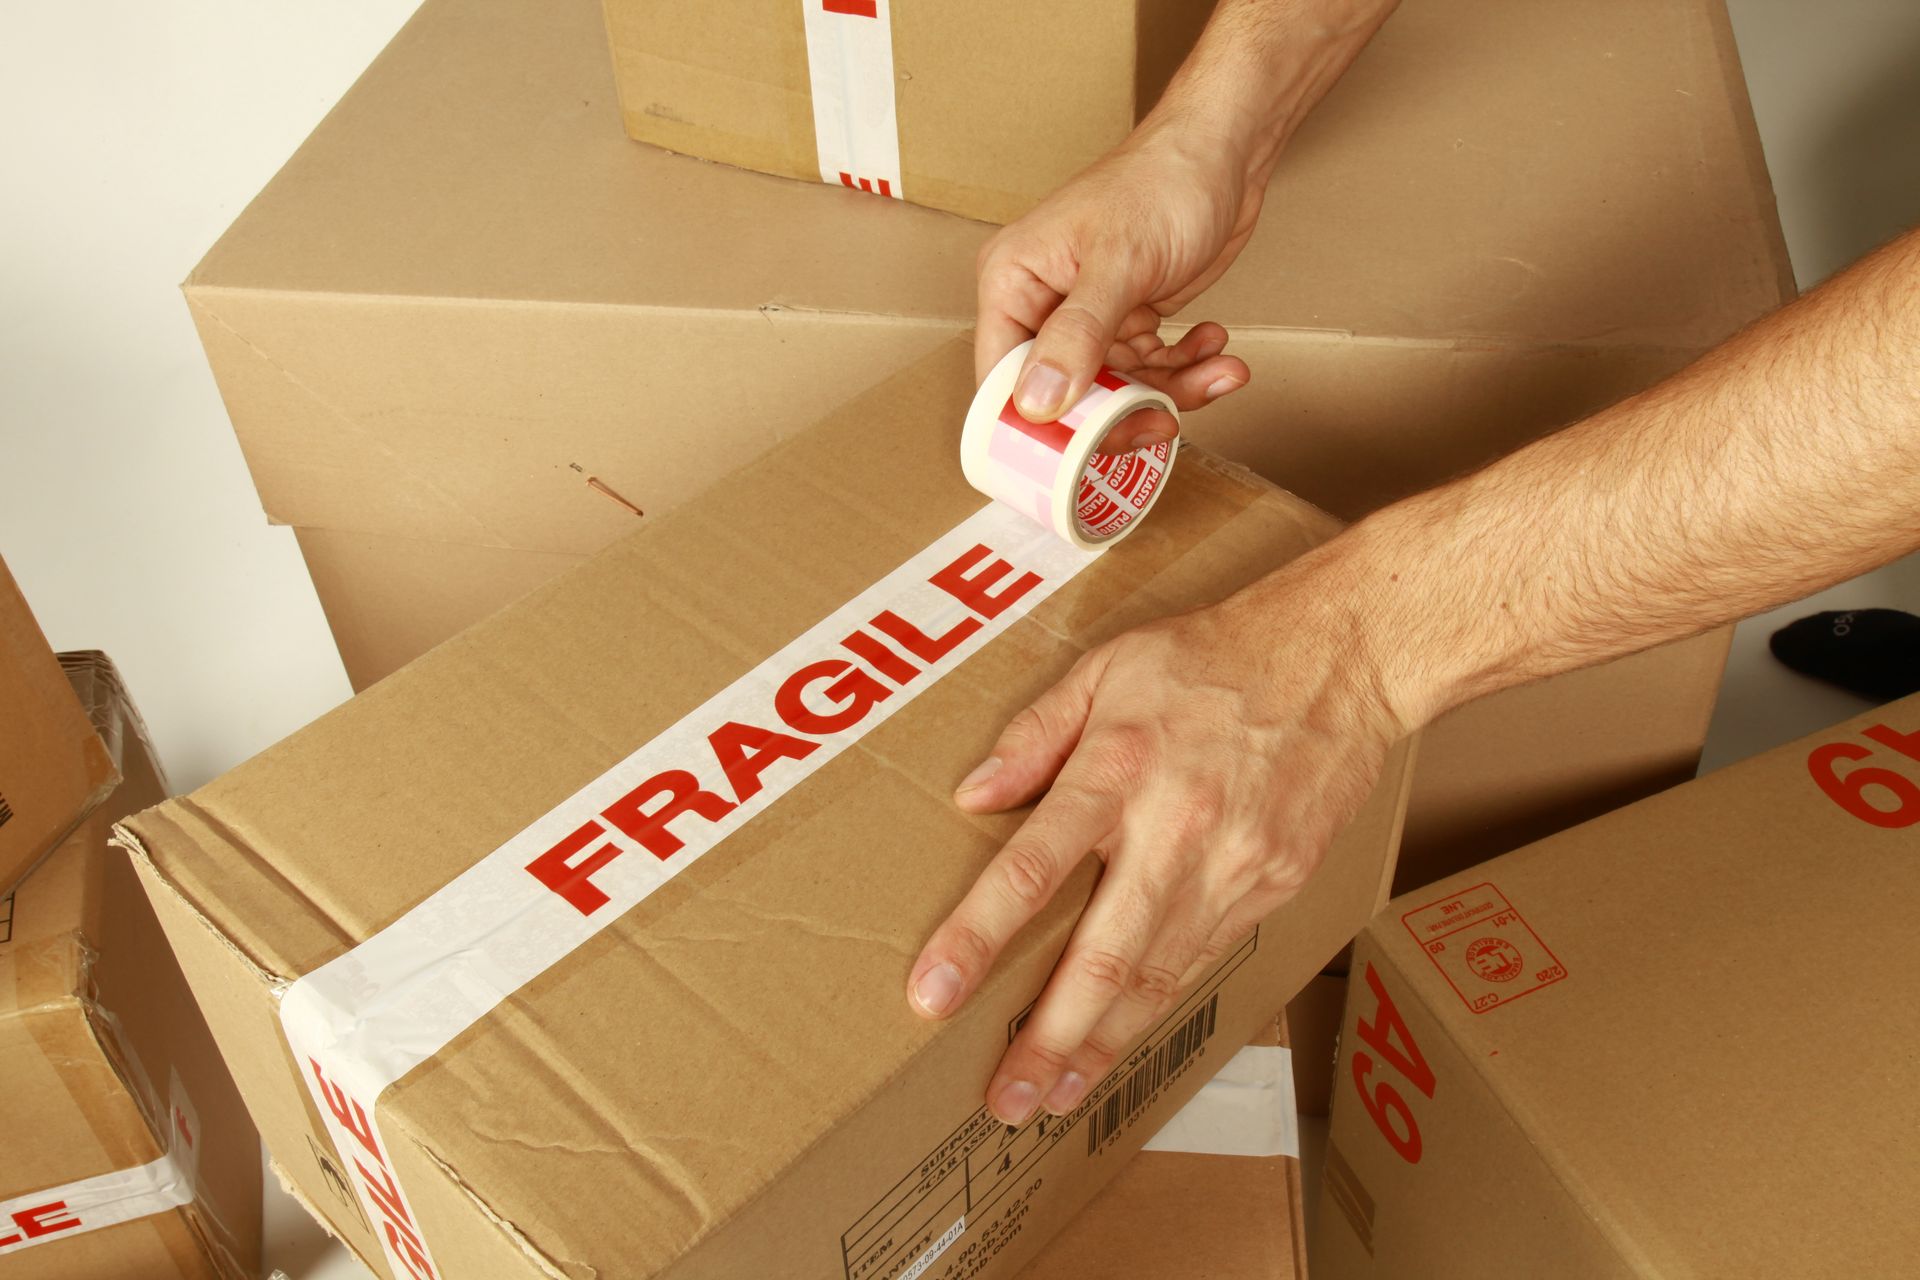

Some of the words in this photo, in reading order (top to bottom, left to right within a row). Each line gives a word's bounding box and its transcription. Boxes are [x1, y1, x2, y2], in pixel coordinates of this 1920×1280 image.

[1134, 468, 1159, 507] PLASTO
[1099, 512, 1130, 535] PLASTO
[524, 544, 1044, 917] FRAGILE
[1440, 901, 1464, 915] LNE
[1429, 942, 1446, 954] 09
[1536, 966, 1561, 982] 2/20
[1352, 960, 1436, 1164] A9
[960, 1119, 1000, 1158] ASSIS
[997, 1151, 1012, 1185] 4
[936, 1178, 1043, 1280] 4.90.53.42.20
[950, 1205, 1030, 1280] w.t-nb.com
[853, 1238, 894, 1280] ITEM
[881, 1230, 934, 1280] ANTITY
[961, 1223, 1023, 1280] -nb.com
